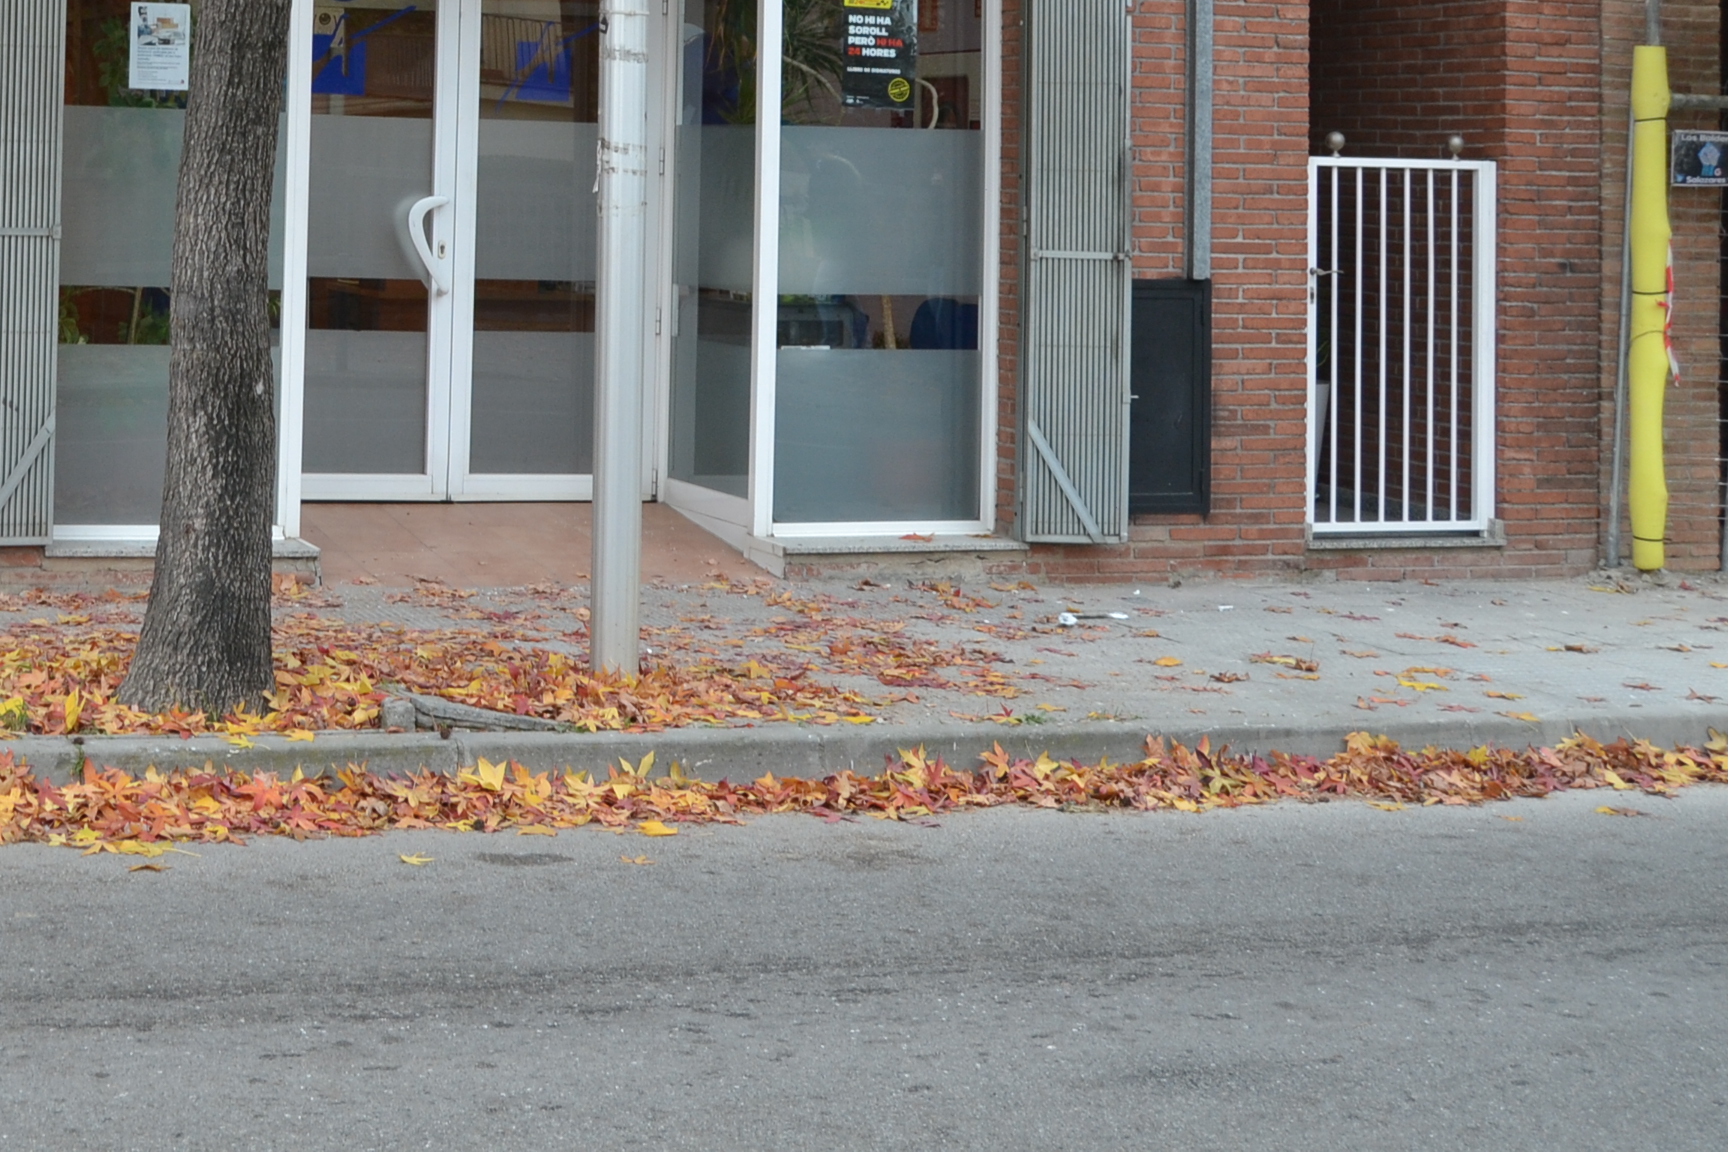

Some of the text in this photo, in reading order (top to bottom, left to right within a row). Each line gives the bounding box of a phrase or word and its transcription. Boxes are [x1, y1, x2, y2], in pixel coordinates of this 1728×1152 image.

[848, 14, 892, 25] NO HI HA
[848, 25, 889, 36] SOROLL
[848, 36, 904, 47] PERÒ HI HA
[848, 47, 897, 58] 24 HORES
